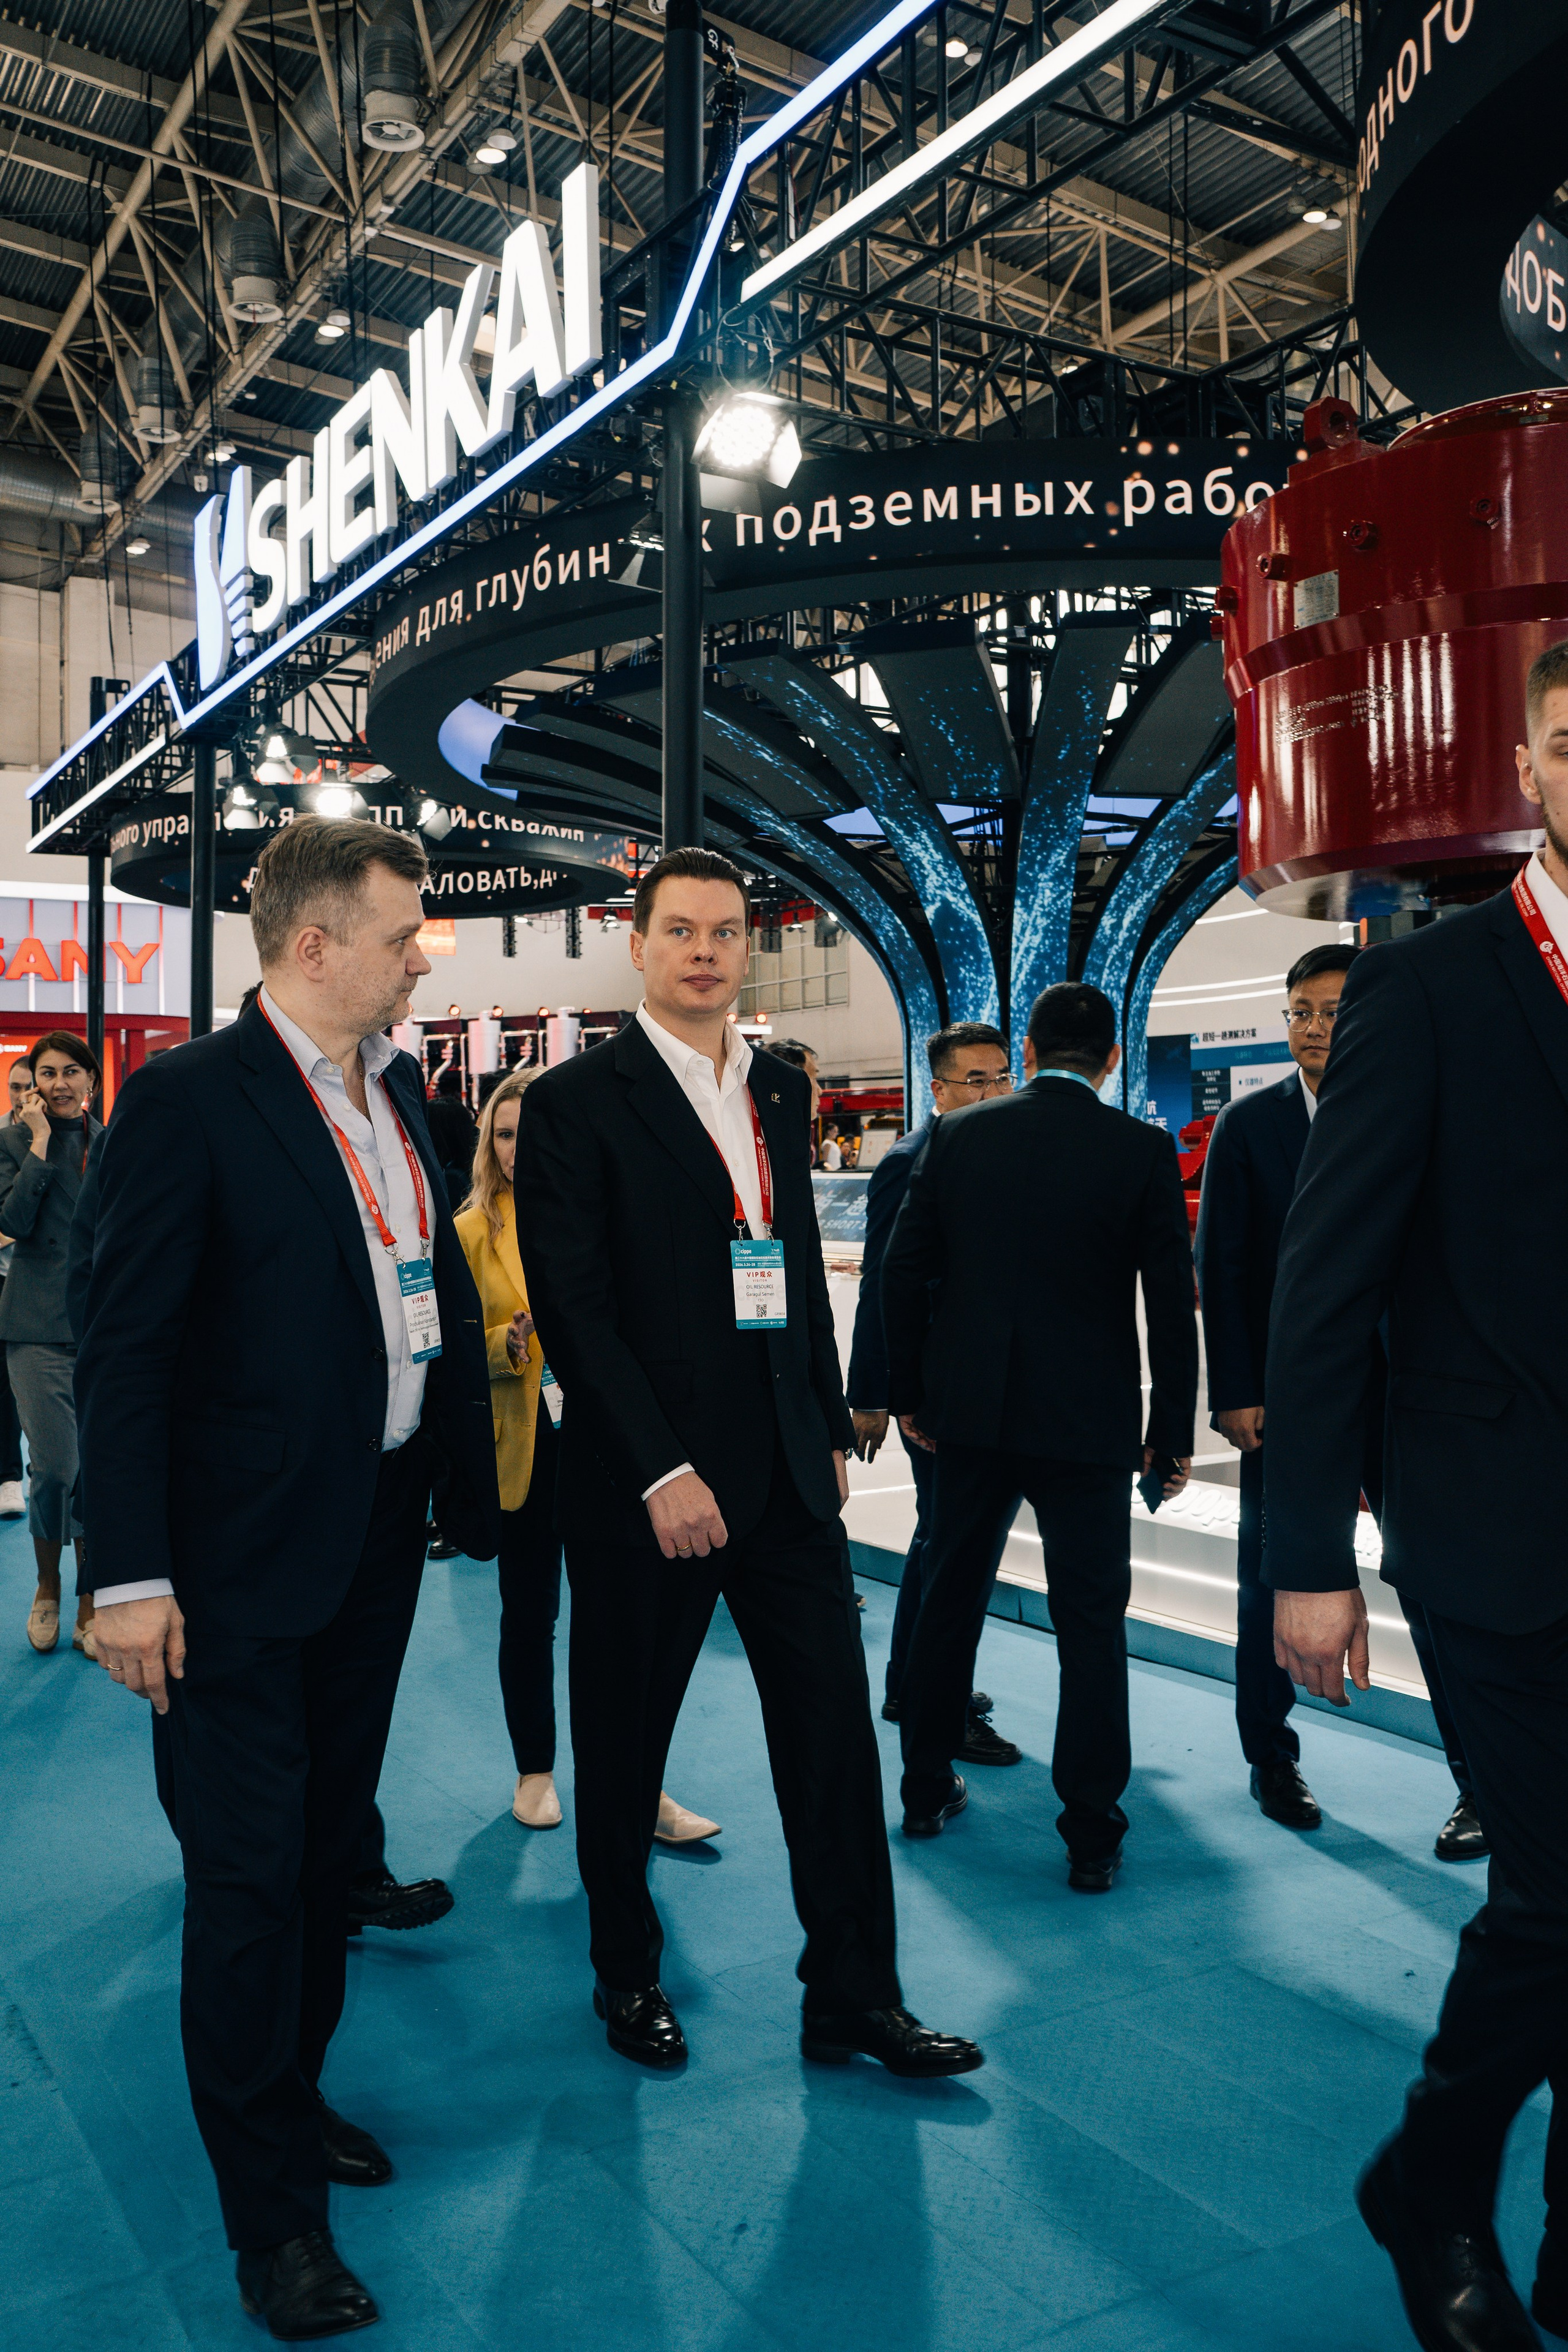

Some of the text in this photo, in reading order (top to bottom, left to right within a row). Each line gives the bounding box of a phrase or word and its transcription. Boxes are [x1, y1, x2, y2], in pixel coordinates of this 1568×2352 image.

[247, 160, 601, 634] SHENKAI
[369, 616, 409, 689] ения
[416, 589, 462, 646] для
[736, 481, 1095, 546] подземных
[1123, 467, 1289, 527] рабо
[1545, 956, 1568, 1001] CHINA NATIONAL OFFSHO
[1552, 954, 1568, 990] 中国海洋石油
